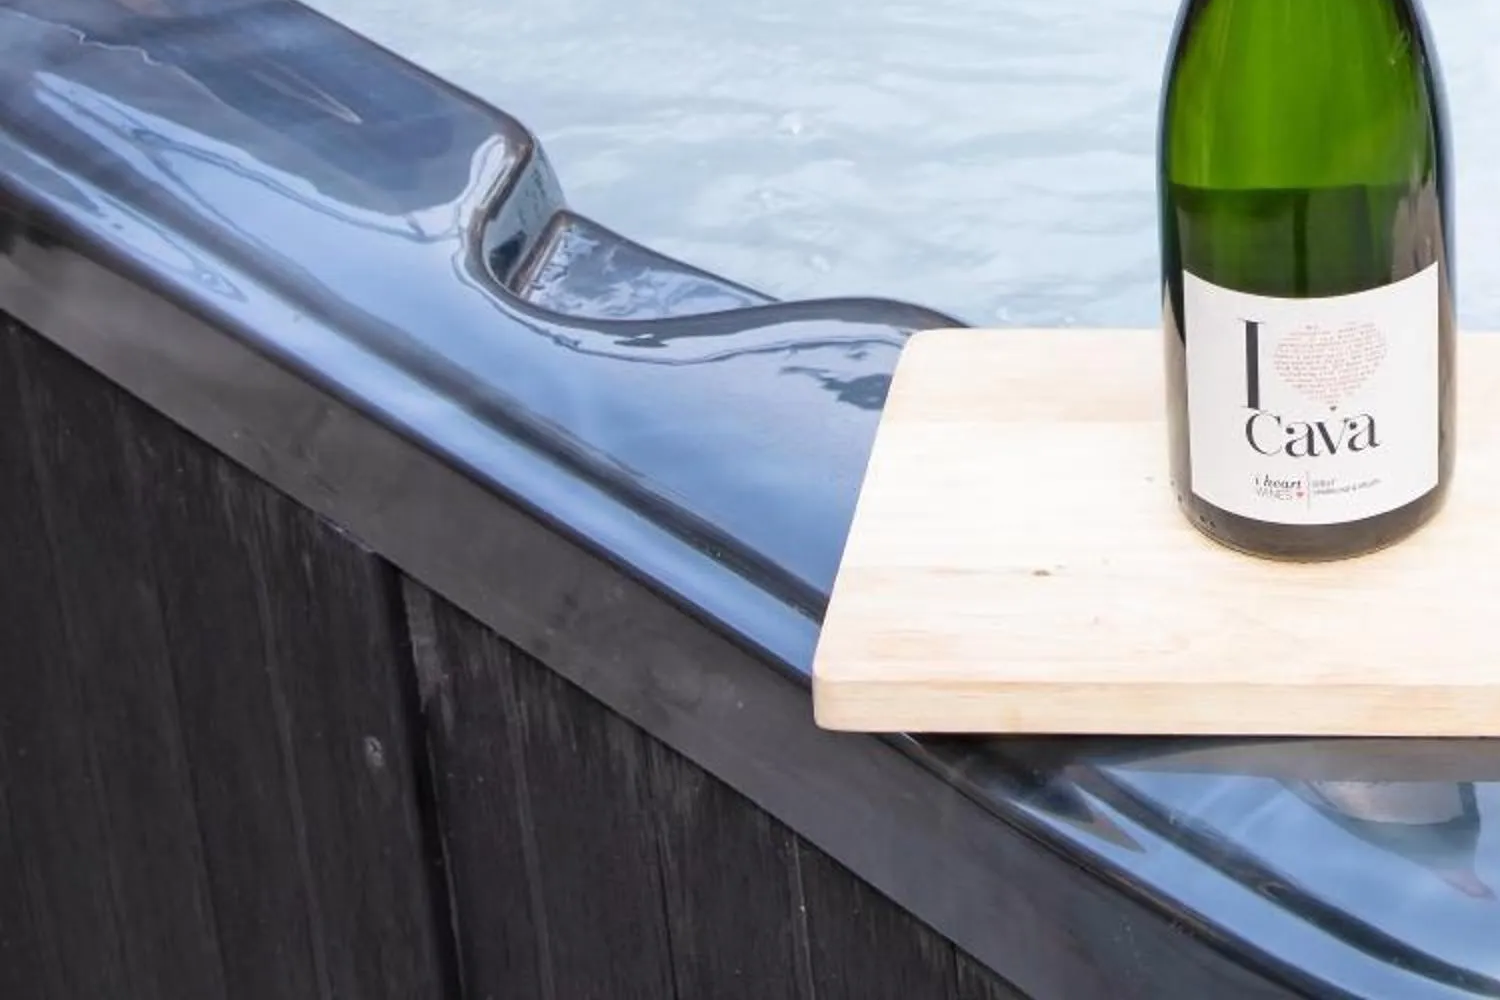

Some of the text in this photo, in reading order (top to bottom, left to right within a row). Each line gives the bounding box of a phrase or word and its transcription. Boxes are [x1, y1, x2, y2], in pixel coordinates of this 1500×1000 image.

[1238, 318, 1265, 412] I
[1245, 412, 1380, 457] Cava
[1263, 473, 1302, 489] heart
